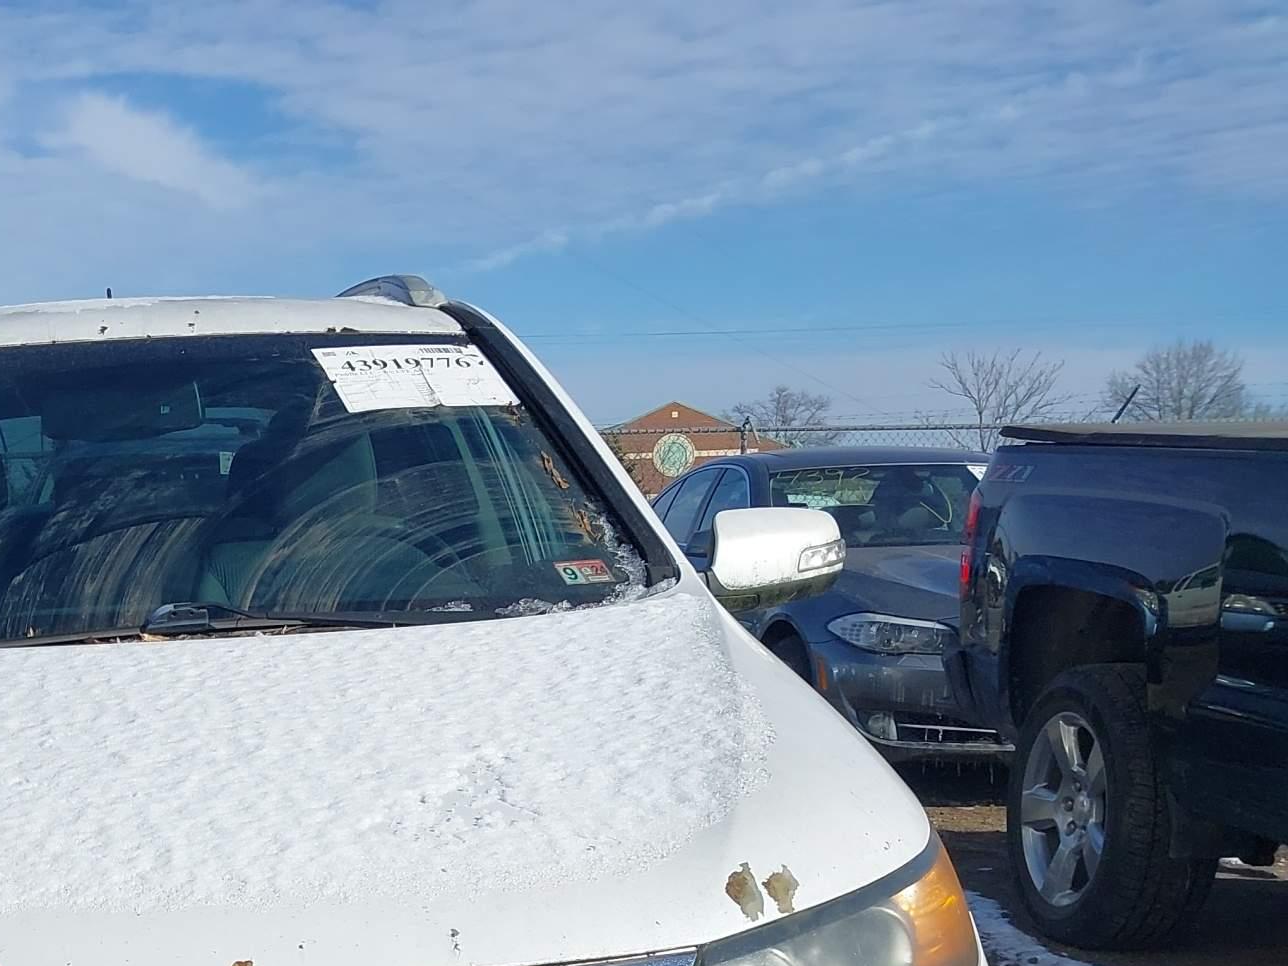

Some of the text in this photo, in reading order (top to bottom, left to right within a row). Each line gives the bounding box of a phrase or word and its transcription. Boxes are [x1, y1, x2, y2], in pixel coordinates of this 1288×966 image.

[341, 355, 472, 372] 43919776
[988, 464, 1035, 482] Z71
[562, 566, 579, 580] 9
